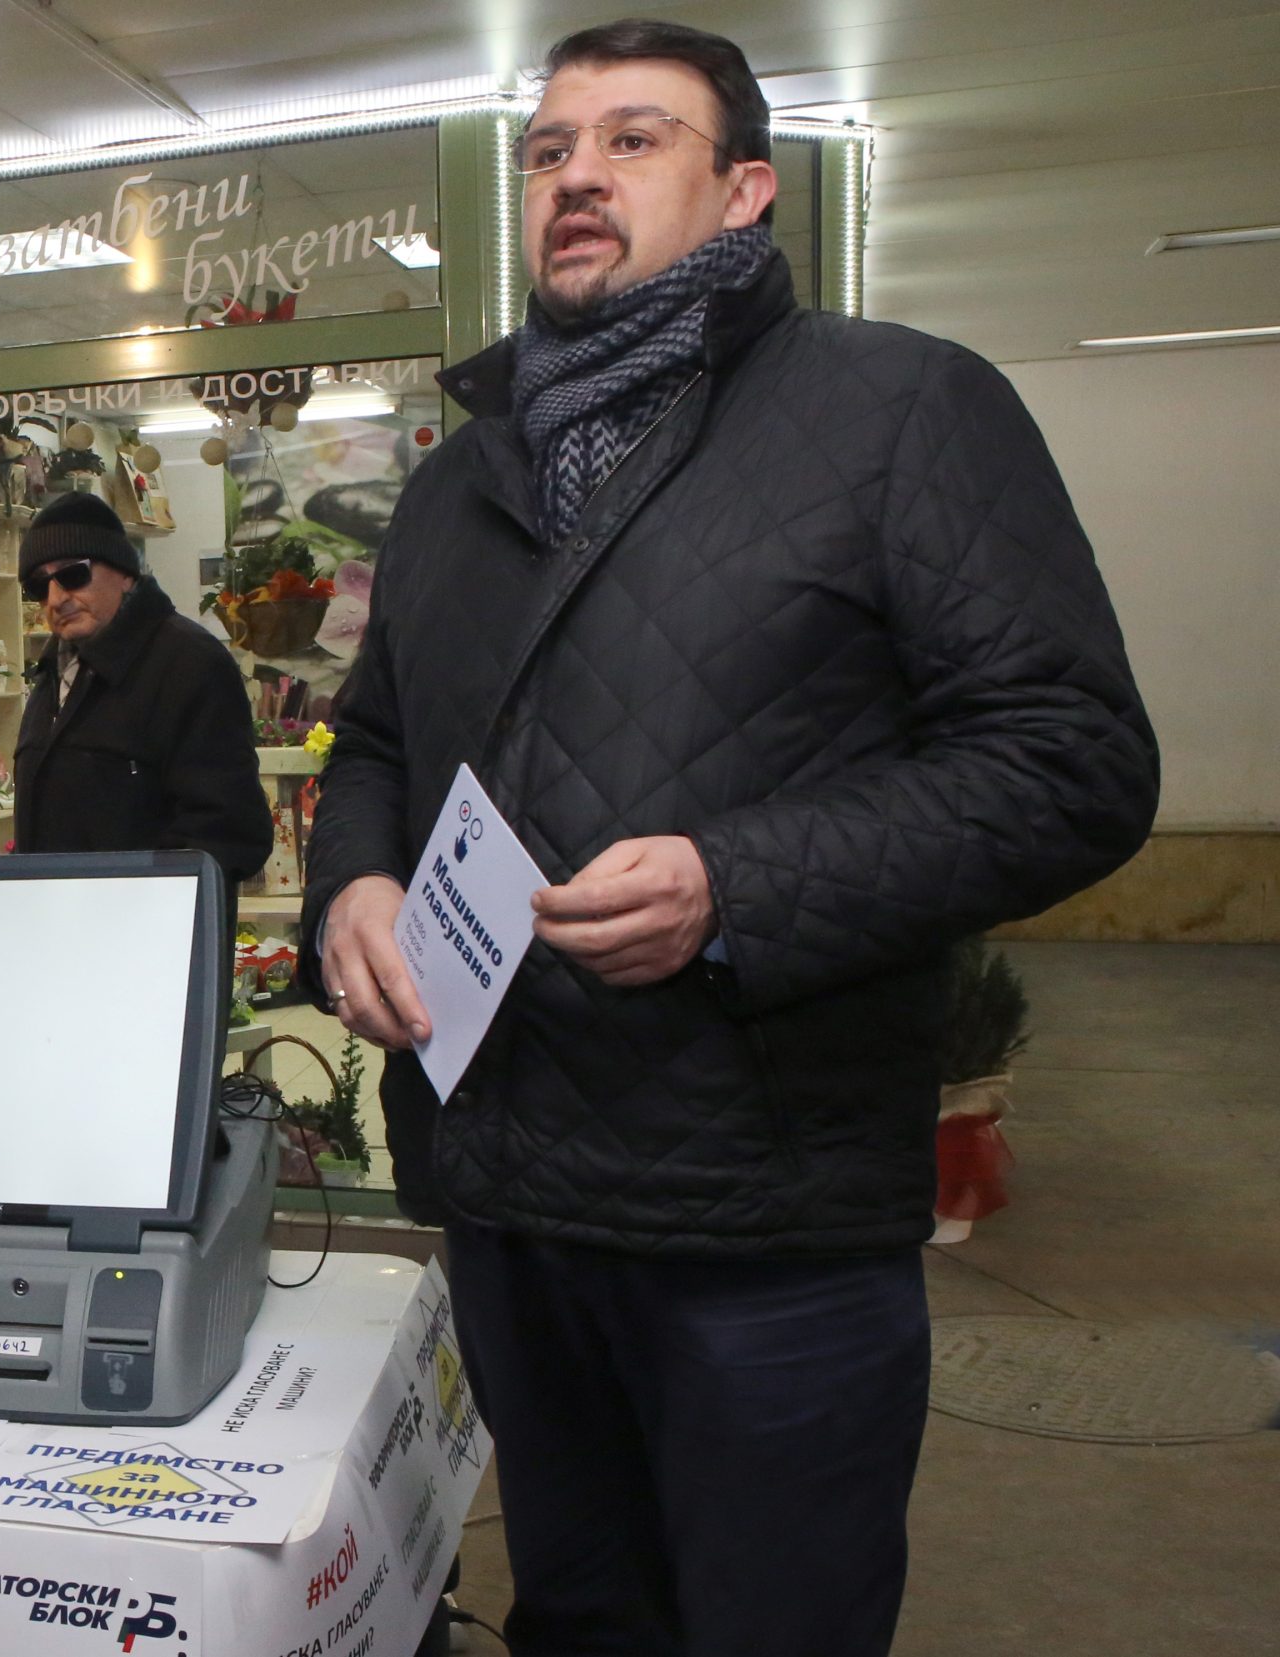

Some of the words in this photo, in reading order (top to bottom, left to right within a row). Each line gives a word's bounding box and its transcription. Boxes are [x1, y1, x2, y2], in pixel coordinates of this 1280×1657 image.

[183, 203, 420, 319] букети
[157, 374, 194, 401] и
[201, 358, 418, 406] доставки
[432, 854, 503, 967] Машинно
[422, 881, 491, 990] гласуване
[246, 1350, 291, 1396] ГЛАСУВАНЕ
[275, 1366, 318, 1411] МАШИНИ?
[221, 1420, 245, 1433] НЕ
[230, 1397, 261, 1419] ИСКА
[26, 1444, 285, 1475] ПРЕДИМСТВО
[117, 1471, 161, 1484] за
[2, 1495, 235, 1524] ГЛАСУВАНЕ
[307, 1523, 359, 1611] #КОЙ
[29, 1602, 114, 1630] БЛОК
[327, 1564, 385, 1649] ГЛАСУВАНЕ
[382, 1553, 390, 1575] С
[349, 1626, 375, 1657] НИ?
